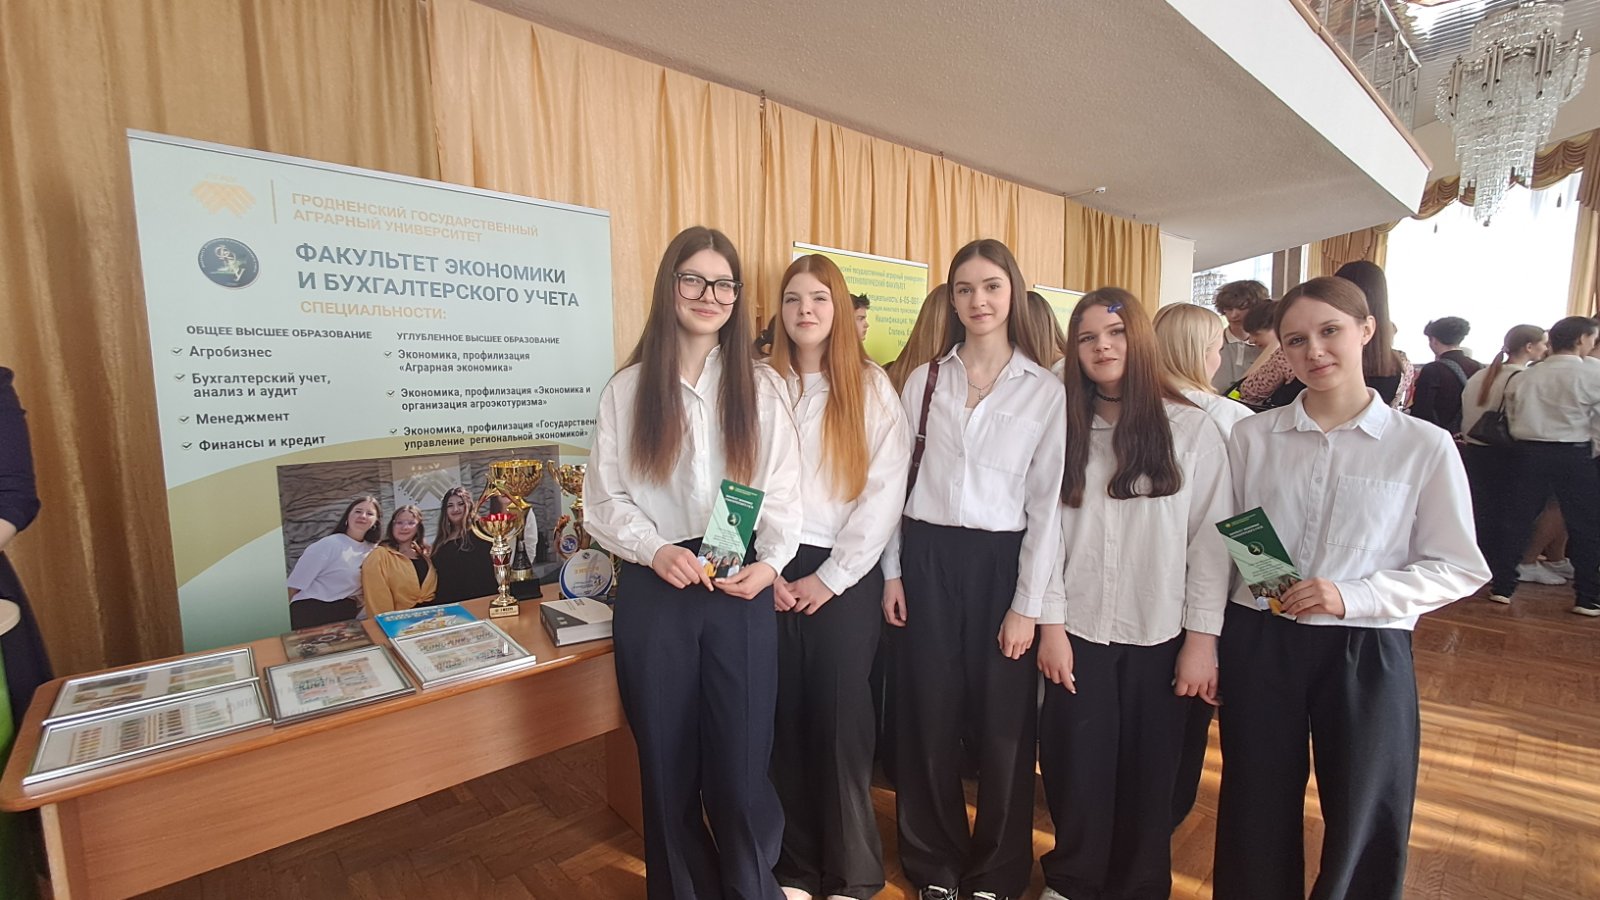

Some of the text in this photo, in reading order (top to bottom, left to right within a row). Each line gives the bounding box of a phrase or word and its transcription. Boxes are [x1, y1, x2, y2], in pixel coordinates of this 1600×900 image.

[291, 192, 539, 237] ГРОДНЕНСКИЙ ГОСУДАРСТВЕННЫЙ
[294, 208, 483, 243] АГРАРНЫЙ УНИВЕРСИТЕТ
[295, 242, 566, 284] ФАКУЛЬТЕТ ЭКОНОМИКИ
[297, 271, 580, 307] И БУХГАЛТЕРСКОГО УЧЕТА
[300, 300, 447, 320] СПЕЦИАЛЬНОСТИ:
[186, 325, 373, 340] ОБЩЕЕ ВЫСШЕЕ ОБРАЗОВАНИЕ
[396, 332, 561, 345] УГЛУБЛЕННОЕ ВЫСШЕЕ ОБРАЗОВАНИЕ
[189, 345, 273, 360] Агробизнес
[398, 349, 531, 362] Экономика, профилизация
[399, 362, 513, 374] «Аграрная экономика»
[192, 372, 332, 387] Бухгалтерский учет,
[193, 387, 298, 399] анализ и аудит
[400, 385, 591, 399] Экономика, профилизация «Экономика и
[401, 398, 548, 413] организация агроэкотуризма»
[196, 412, 290, 425] Менеджмент
[403, 426, 465, 437] Экономика,
[467, 421, 534, 434] профилизация
[198, 435, 326, 452] Финансы и кредит
[404, 429, 588, 451] управление региональной экономикой»
